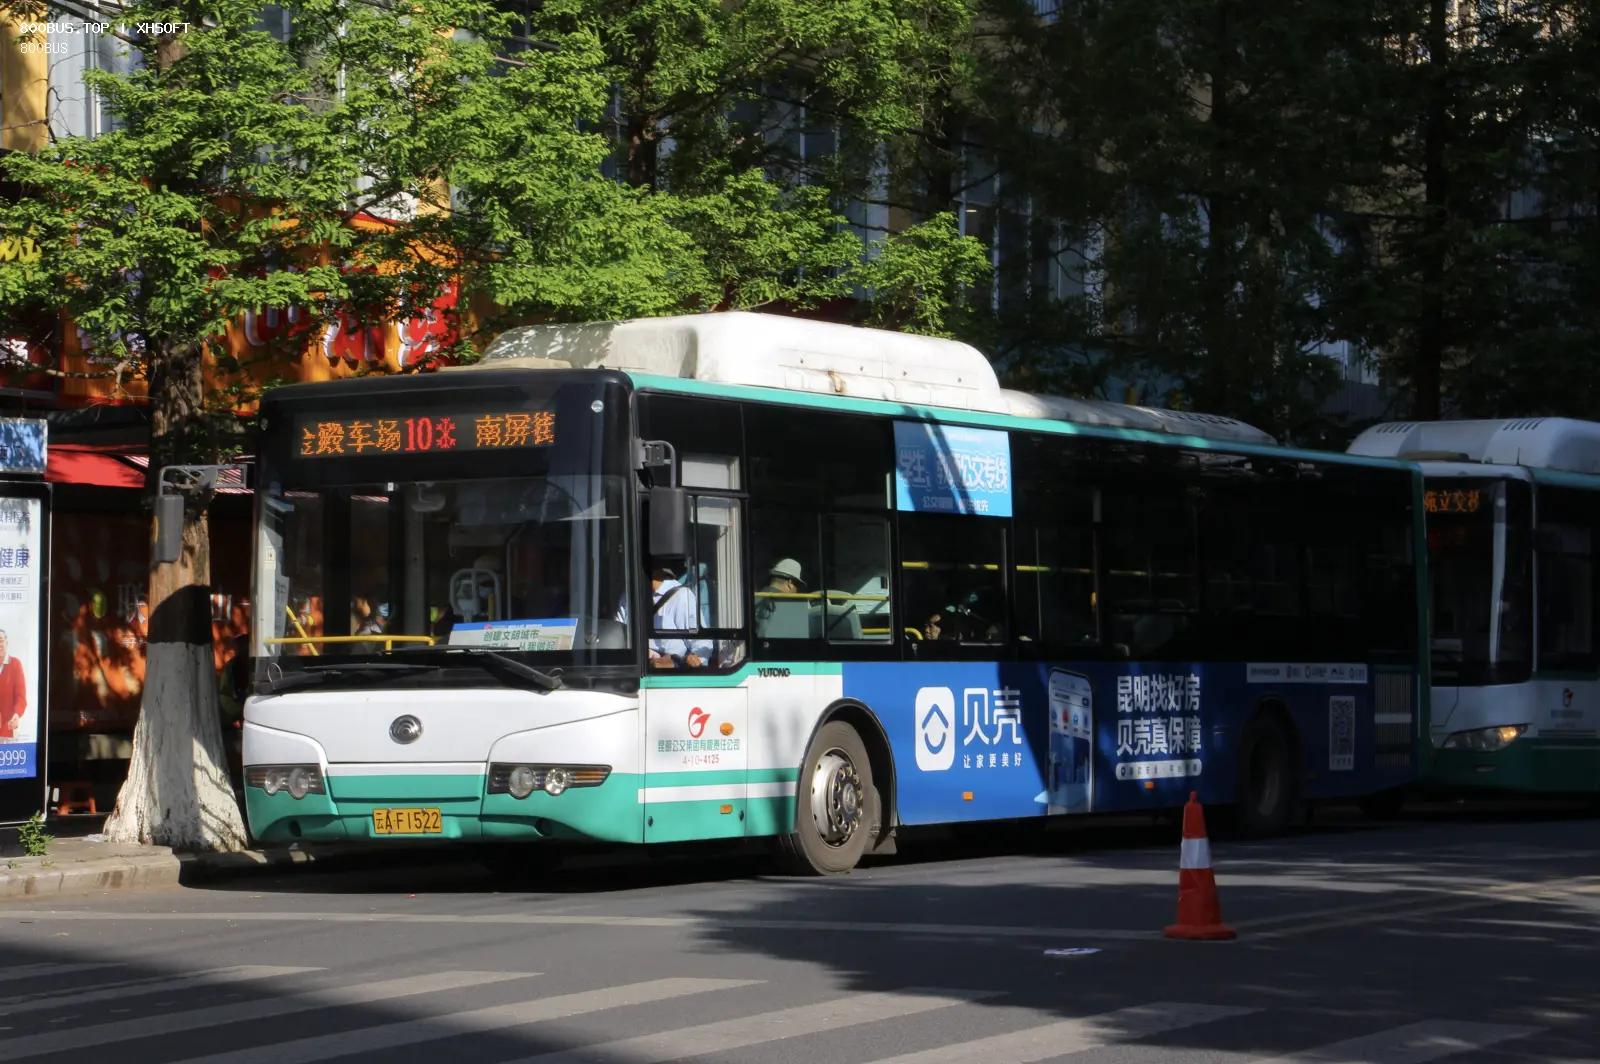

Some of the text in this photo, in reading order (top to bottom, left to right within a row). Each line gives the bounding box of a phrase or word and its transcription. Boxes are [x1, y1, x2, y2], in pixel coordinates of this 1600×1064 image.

[757, 667, 791, 678] YUTONG
[1116, 672, 1201, 713] 昆明找好房
[963, 684, 1022, 747] 贝壳
[1116, 715, 1202, 757] 贝壳真保障
[657, 739, 740, 753] 昆明公交集团有限责任公司
[682, 753, 720, 766] 4-10-4125
[963, 752, 1022, 769] 让家更美好
